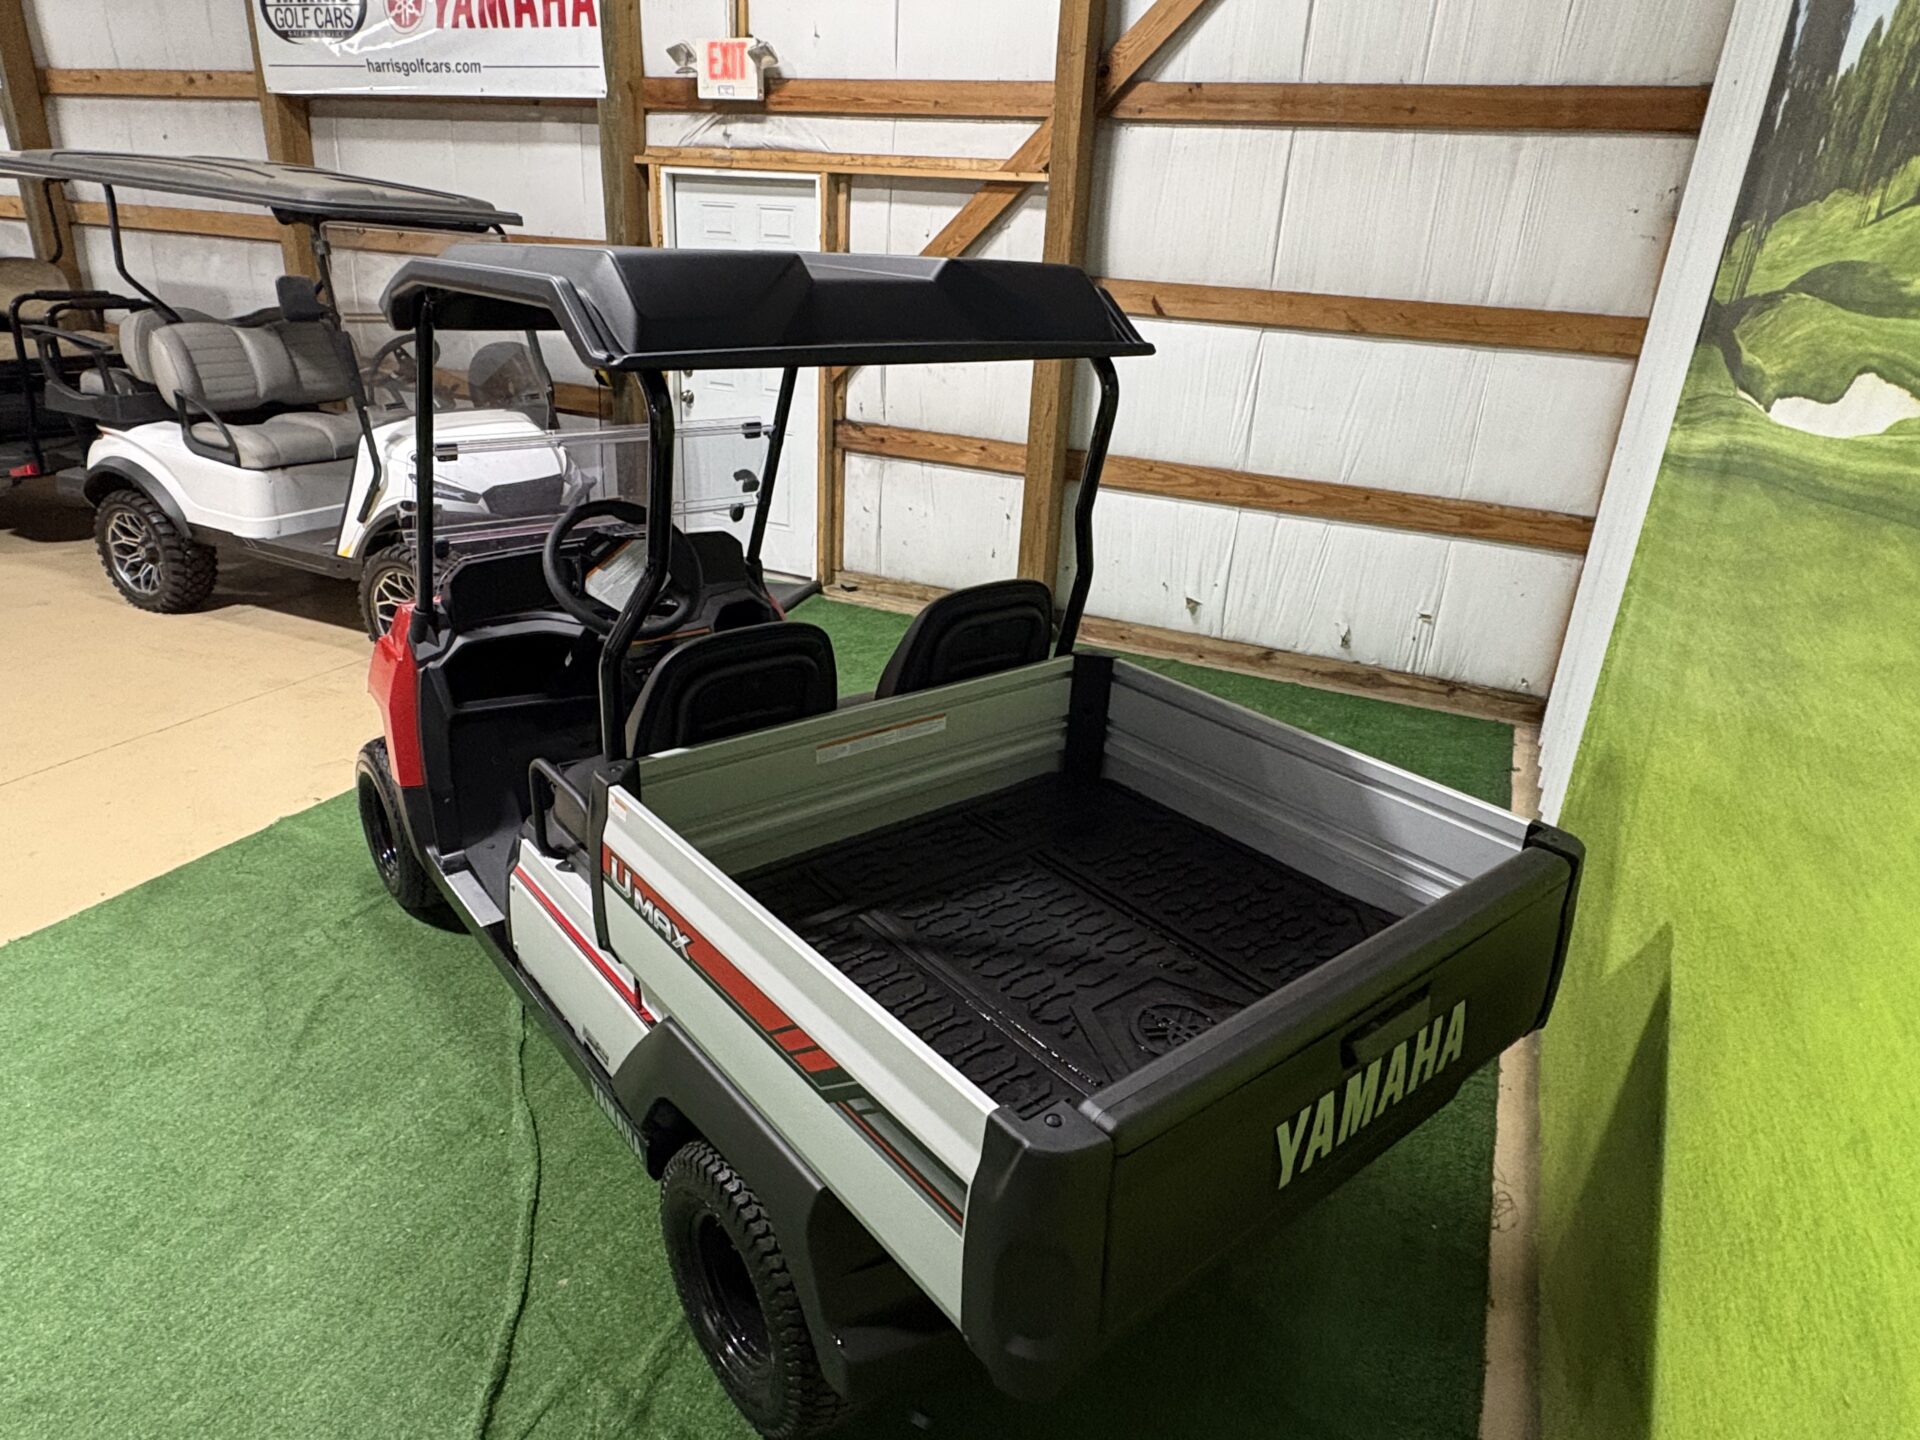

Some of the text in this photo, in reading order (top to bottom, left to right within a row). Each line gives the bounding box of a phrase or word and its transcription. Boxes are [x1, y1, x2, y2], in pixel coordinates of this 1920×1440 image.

[274, 7, 354, 28] GOLF CARS
[366, 58, 482, 76] harrisgolfcars.com
[707, 42, 747, 80] EXIT
[611, 855, 692, 960] U MAX
[1276, 999, 1466, 1190] YAMAHA
